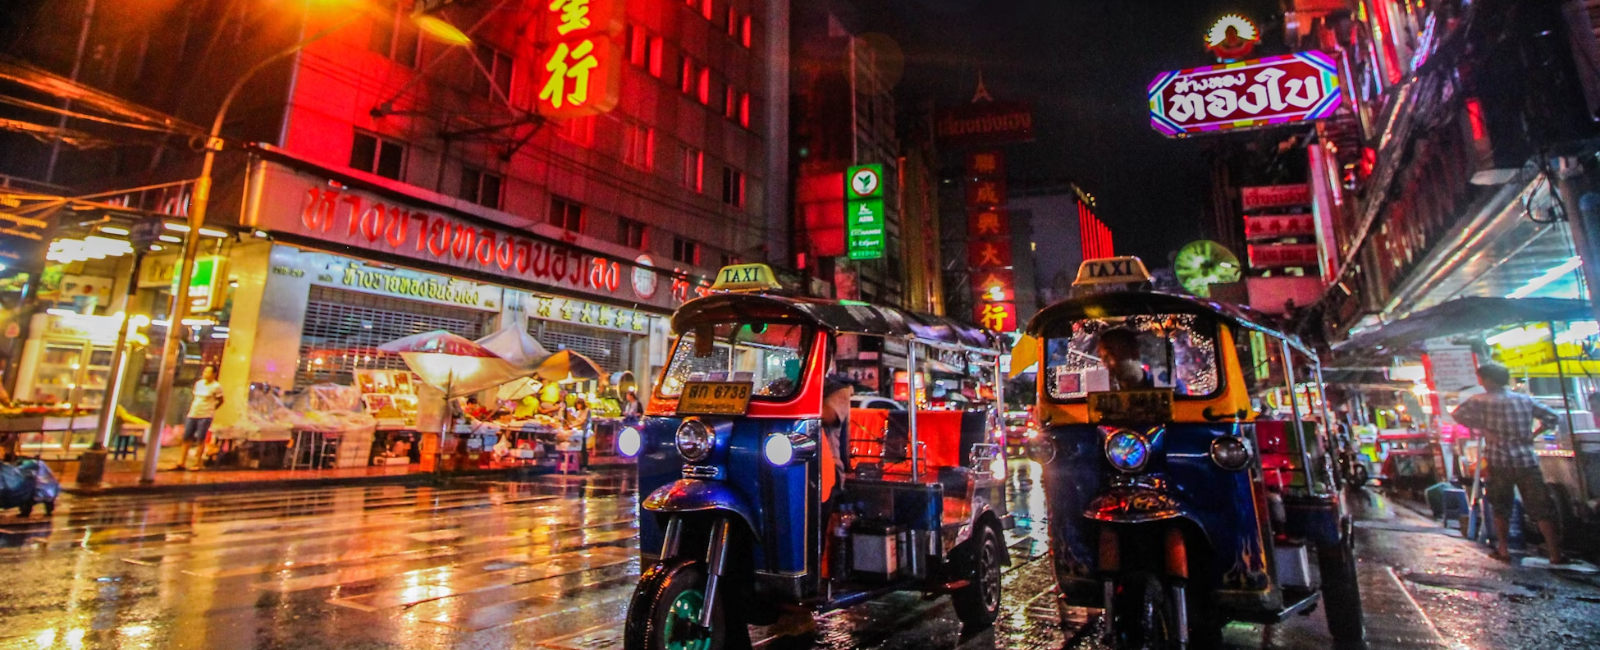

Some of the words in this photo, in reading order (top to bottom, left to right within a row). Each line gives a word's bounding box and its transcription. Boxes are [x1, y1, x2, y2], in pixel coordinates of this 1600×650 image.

[1174, 72, 1246, 94] ห้างทอง
[724, 267, 759, 283] TAXI
[1086, 260, 1132, 278] TAXI
[714, 384, 747, 400] 6738
